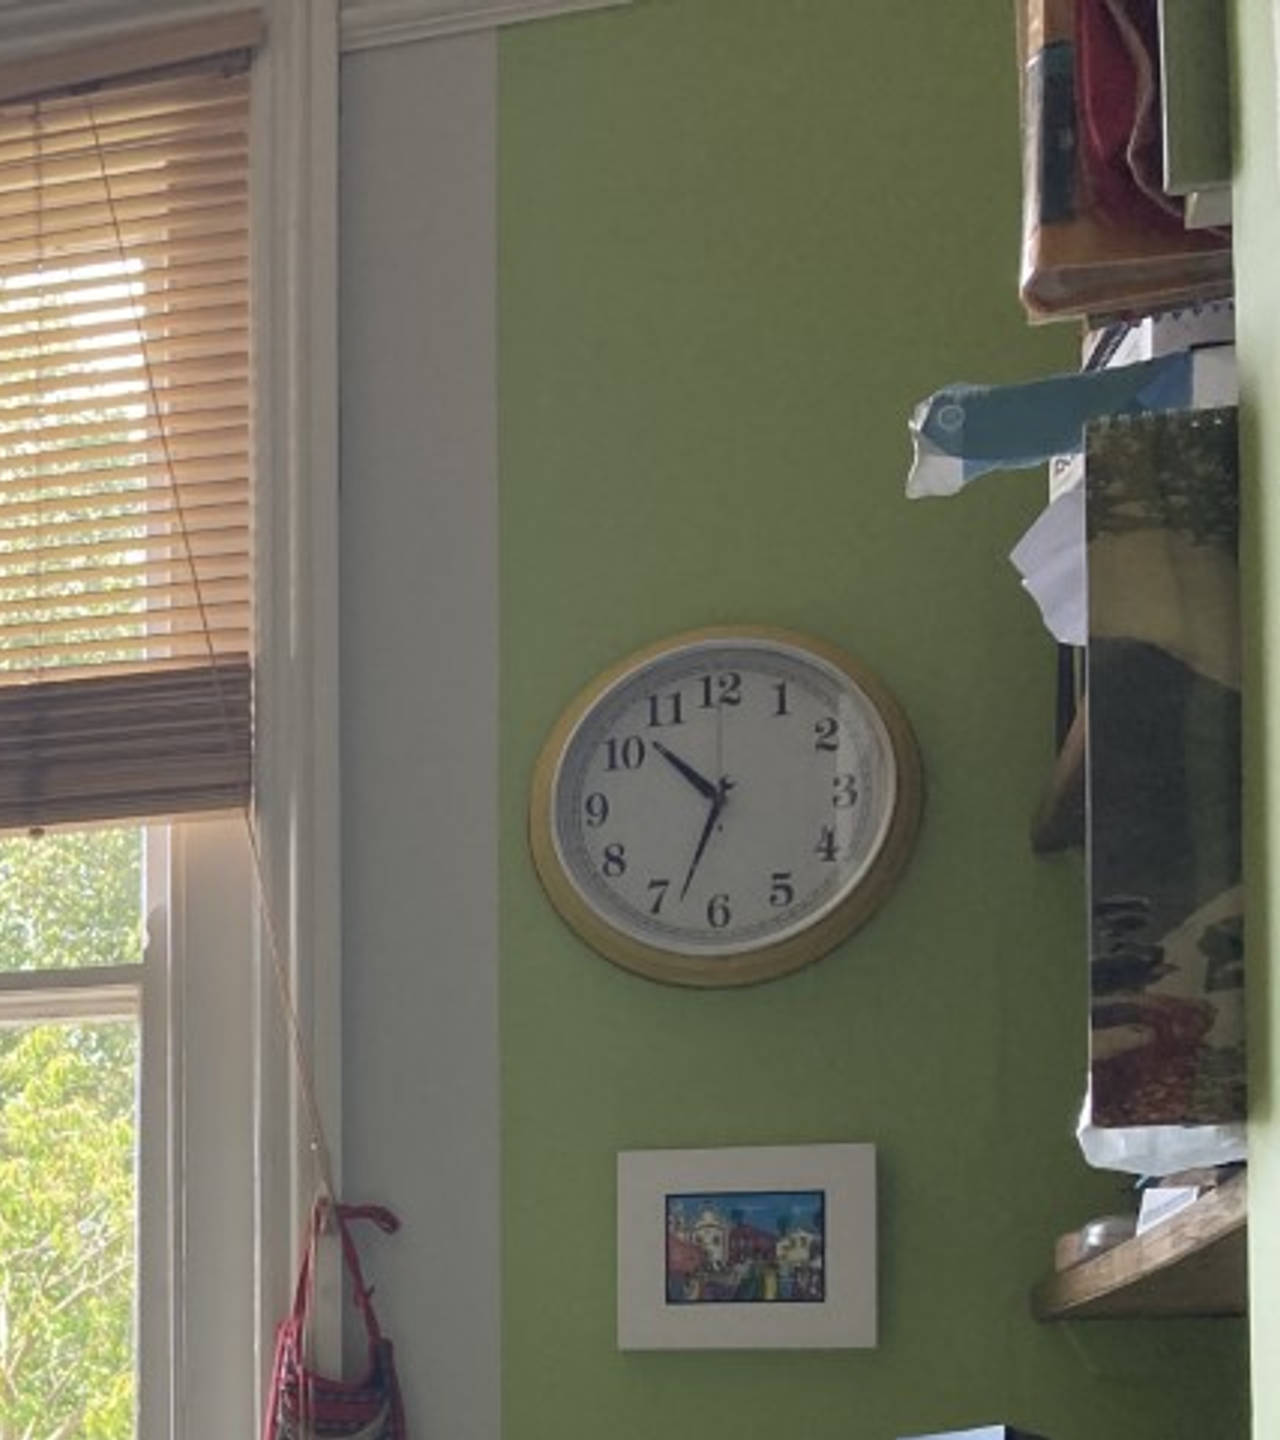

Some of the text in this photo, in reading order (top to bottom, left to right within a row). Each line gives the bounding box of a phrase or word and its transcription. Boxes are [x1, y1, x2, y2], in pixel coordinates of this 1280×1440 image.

[698, 673, 741, 708] 12
[773, 683, 791, 715] 1
[648, 692, 685, 727] 11
[814, 718, 839, 752] 2
[604, 736, 645, 771] 10
[832, 775, 858, 808] 3
[586, 793, 609, 828] 9
[602, 843, 626, 877] 8
[815, 827, 838, 862] 4
[648, 880, 669, 914] 7
[769, 873, 794, 907] 5
[707, 895, 730, 928] 6
